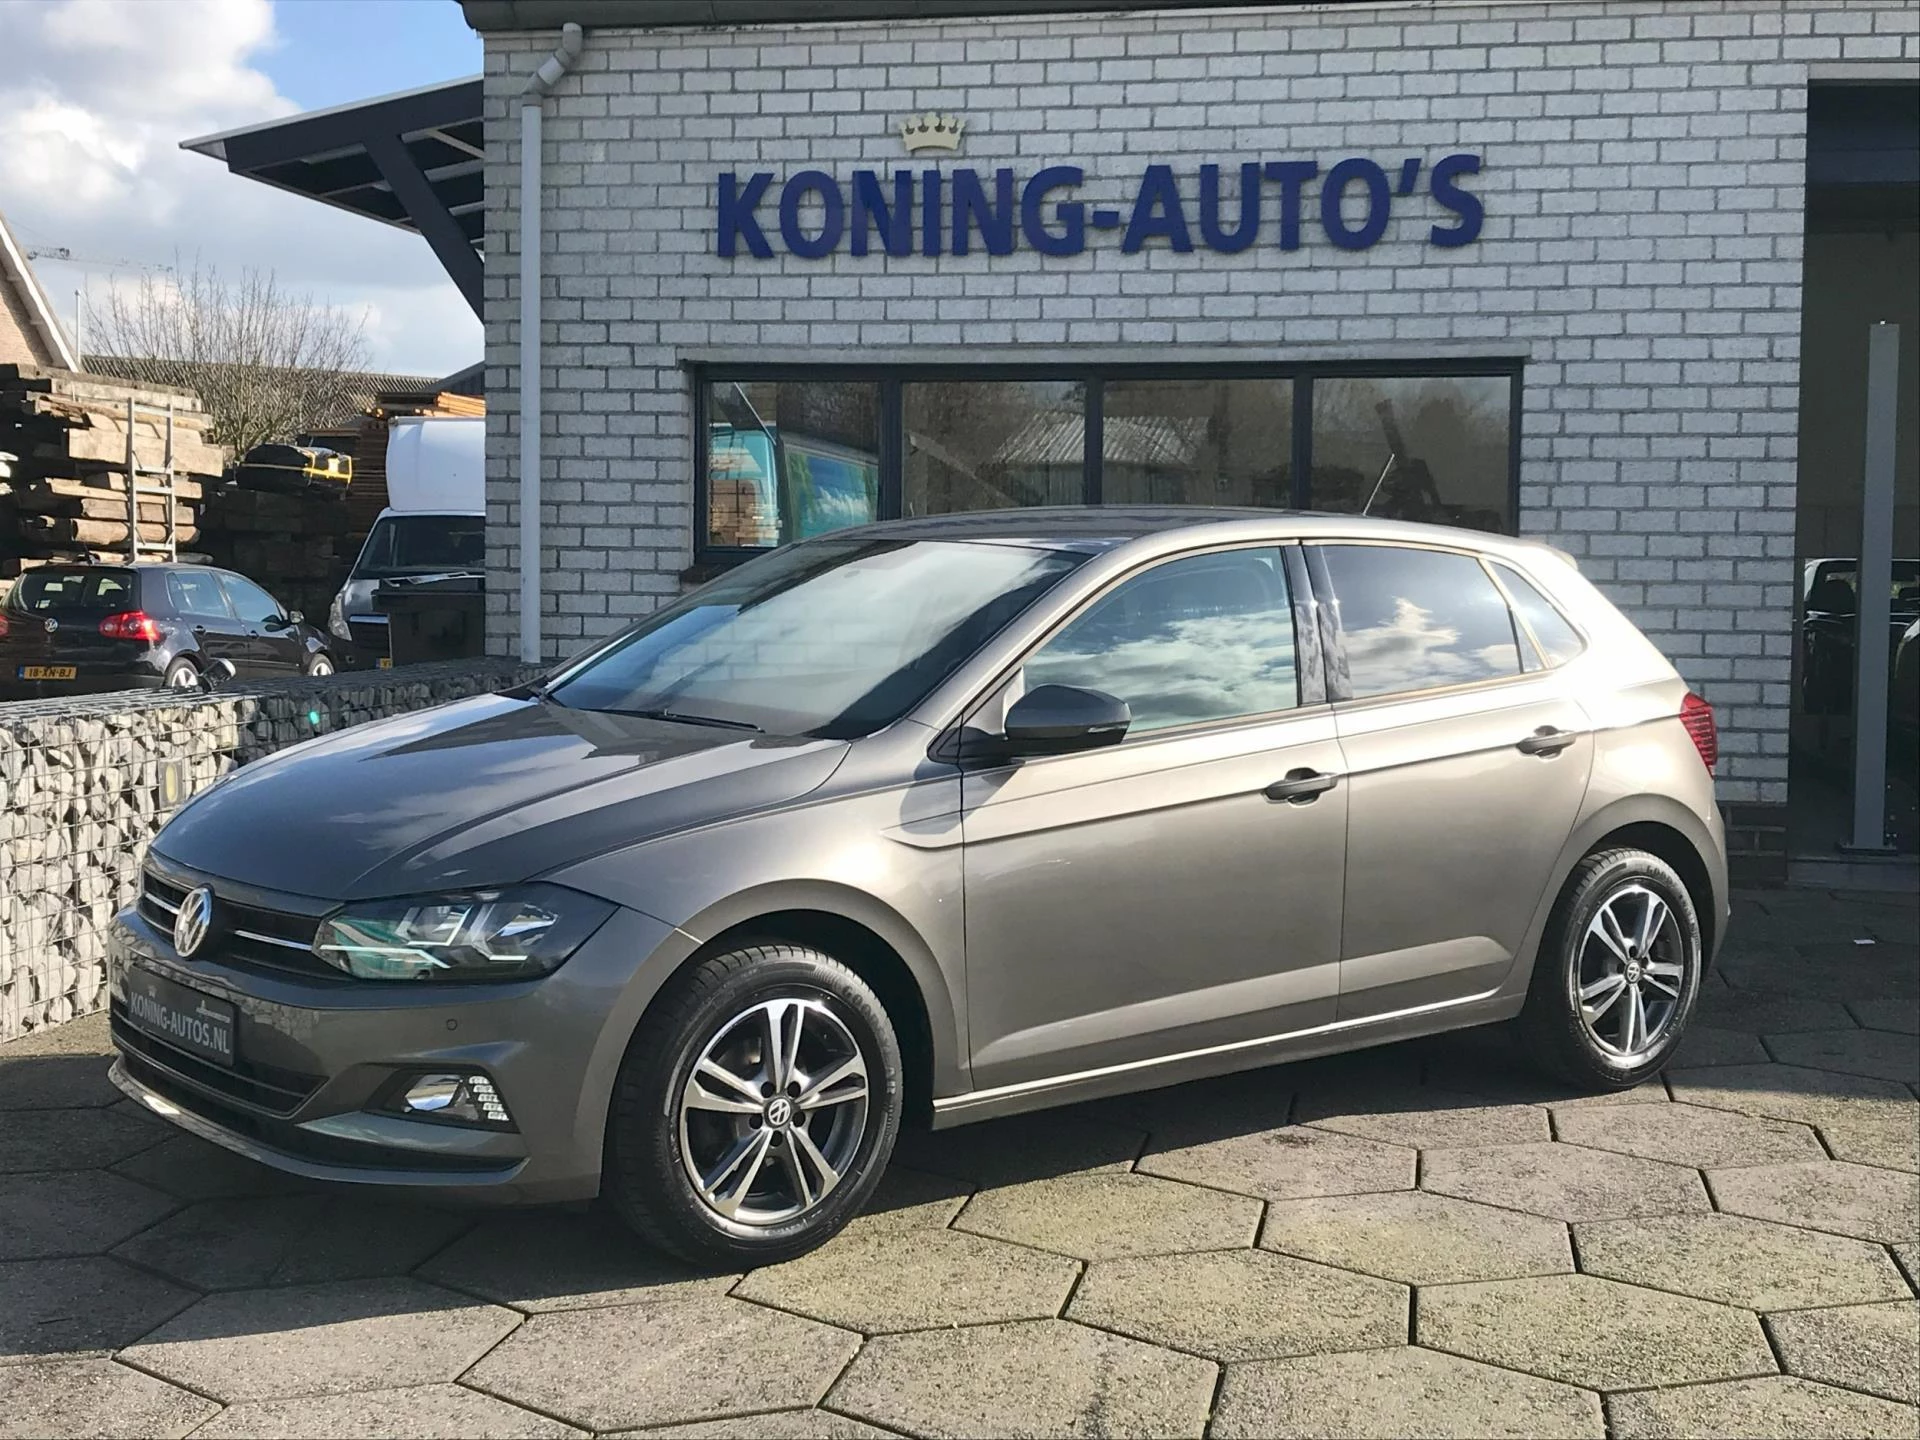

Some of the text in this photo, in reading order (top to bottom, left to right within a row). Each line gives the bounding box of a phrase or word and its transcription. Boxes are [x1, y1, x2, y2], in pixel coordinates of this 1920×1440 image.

[715, 153, 1484, 259] KONING-AUTO'S
[28, 667, 73, 678] 18-XN-BJ
[130, 991, 231, 1054] KONING-AUTOS.NL
